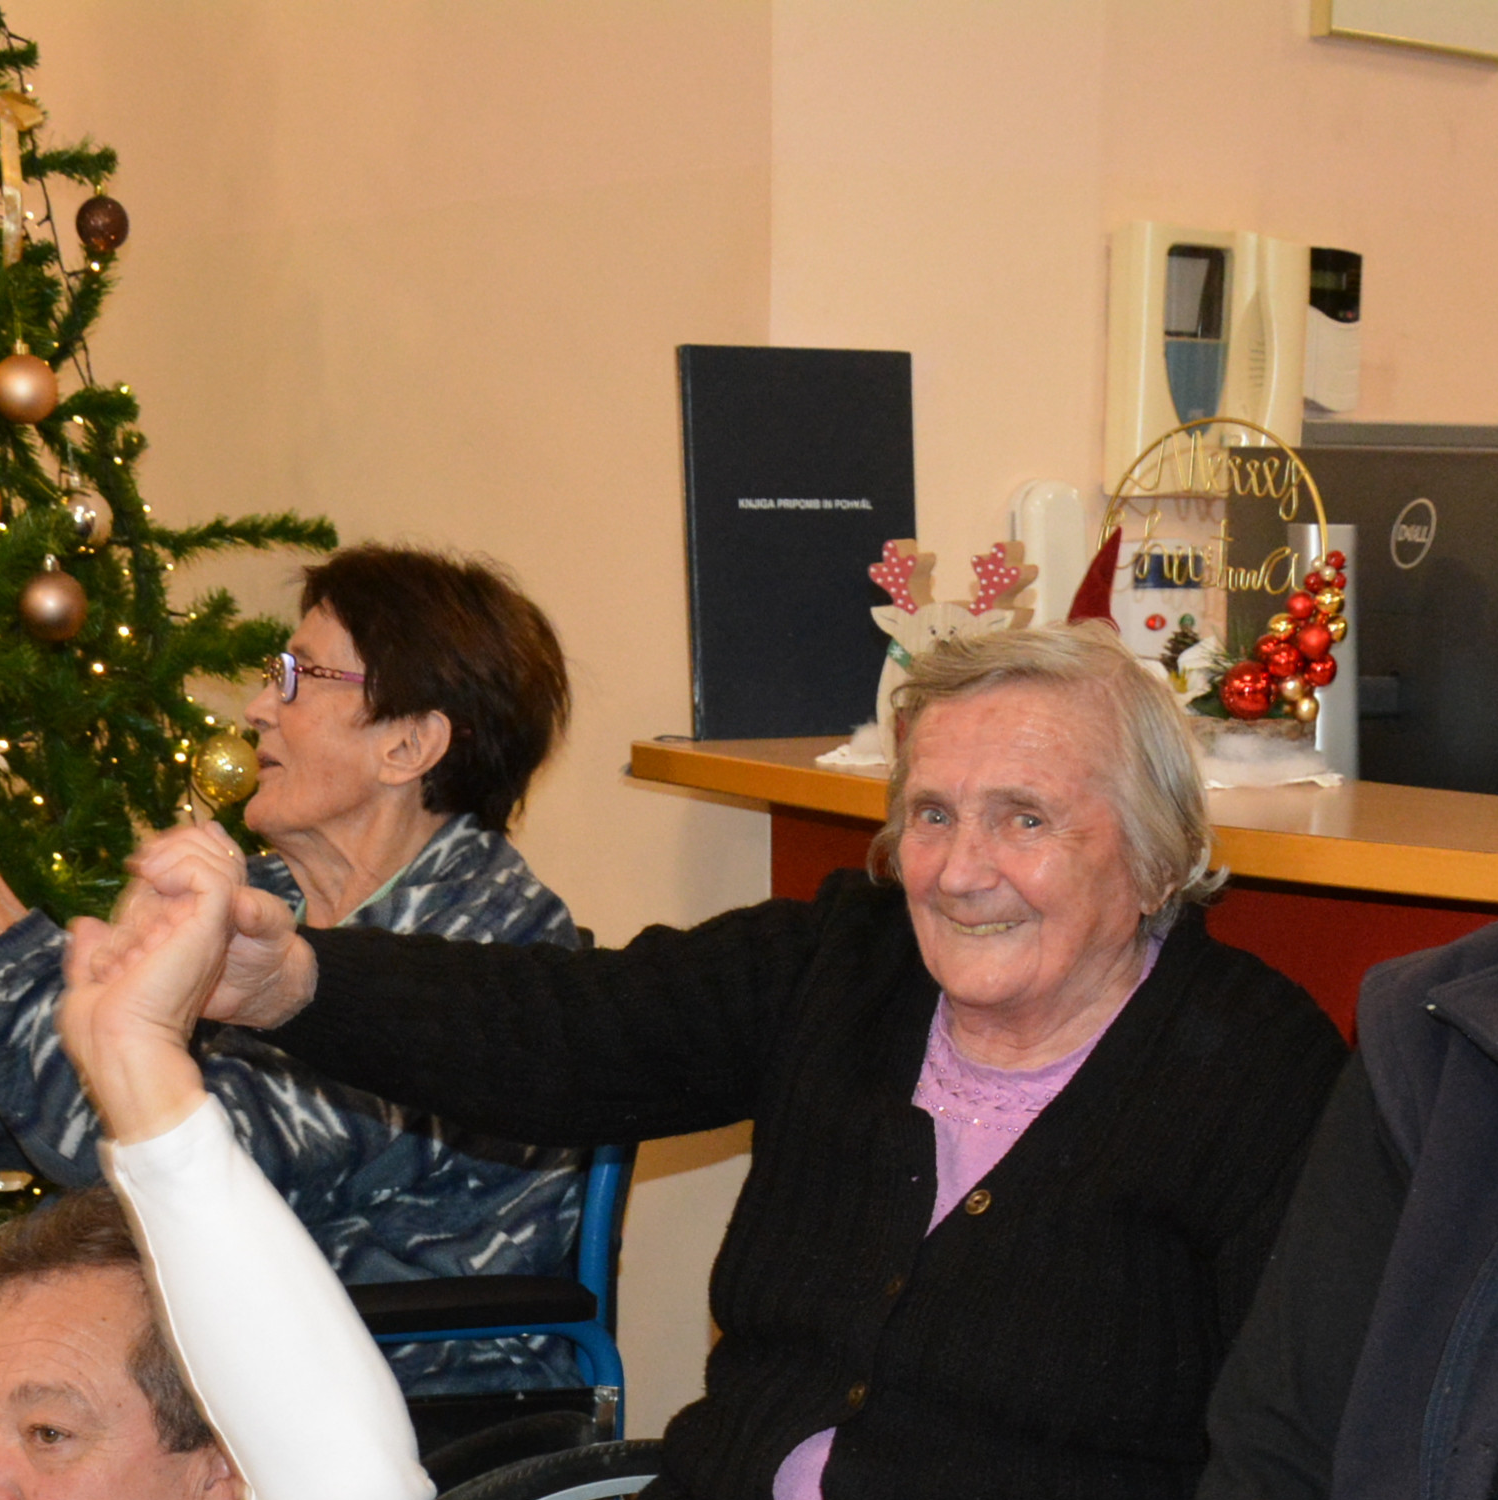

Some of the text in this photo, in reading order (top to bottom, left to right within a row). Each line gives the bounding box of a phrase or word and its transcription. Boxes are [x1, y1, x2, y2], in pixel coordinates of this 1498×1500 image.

[1125, 430, 1304, 521] Merry
[738, 498, 775, 509] KNJIGA
[777, 498, 820, 509] PRIPOMB
[822, 499, 833, 509] IN
[1398, 524, 1429, 542] DELL
